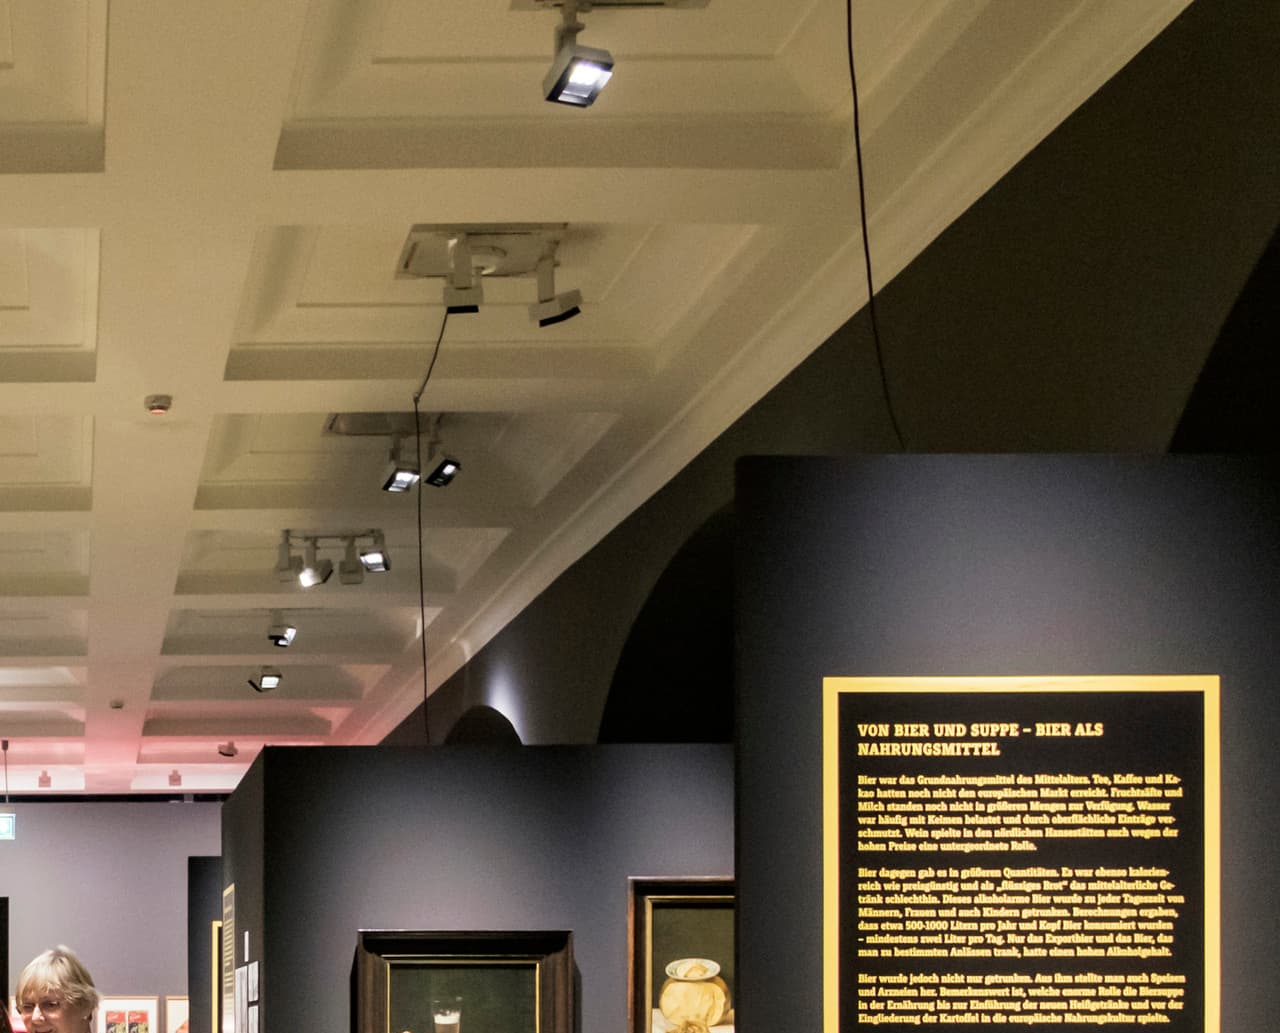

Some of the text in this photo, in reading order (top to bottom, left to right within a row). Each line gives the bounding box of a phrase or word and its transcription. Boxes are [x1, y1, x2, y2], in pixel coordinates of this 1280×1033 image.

[857, 724, 890, 737] VON
[894, 724, 930, 737] BIER
[933, 723, 967, 737] UND
[970, 723, 1020, 737] SUPPE
[1035, 723, 1072, 736] BIER
[1074, 723, 1104, 736] ALS
[858, 742, 1001, 756] NAHRUNGSMITTEL
[858, 920, 879, 930] dass
[880, 922, 904, 930] etwa
[979, 922, 996, 932] pro
[997, 920, 1018, 932] Jahr
[1018, 920, 1038, 930] und
[1038, 920, 1062, 932] Kopf
[1062, 920, 1082, 930] Bier
[1137, 920, 1174, 930] wurden
[858, 1013, 921, 1025] Eingliederung
[922, 1013, 938, 1023] der
[939, 1013, 980, 1023] Kartoffel
[981, 1013, 991, 1023] in
[992, 1013, 1008, 1023] die
[1008, 1011, 1063, 1025] europäische
